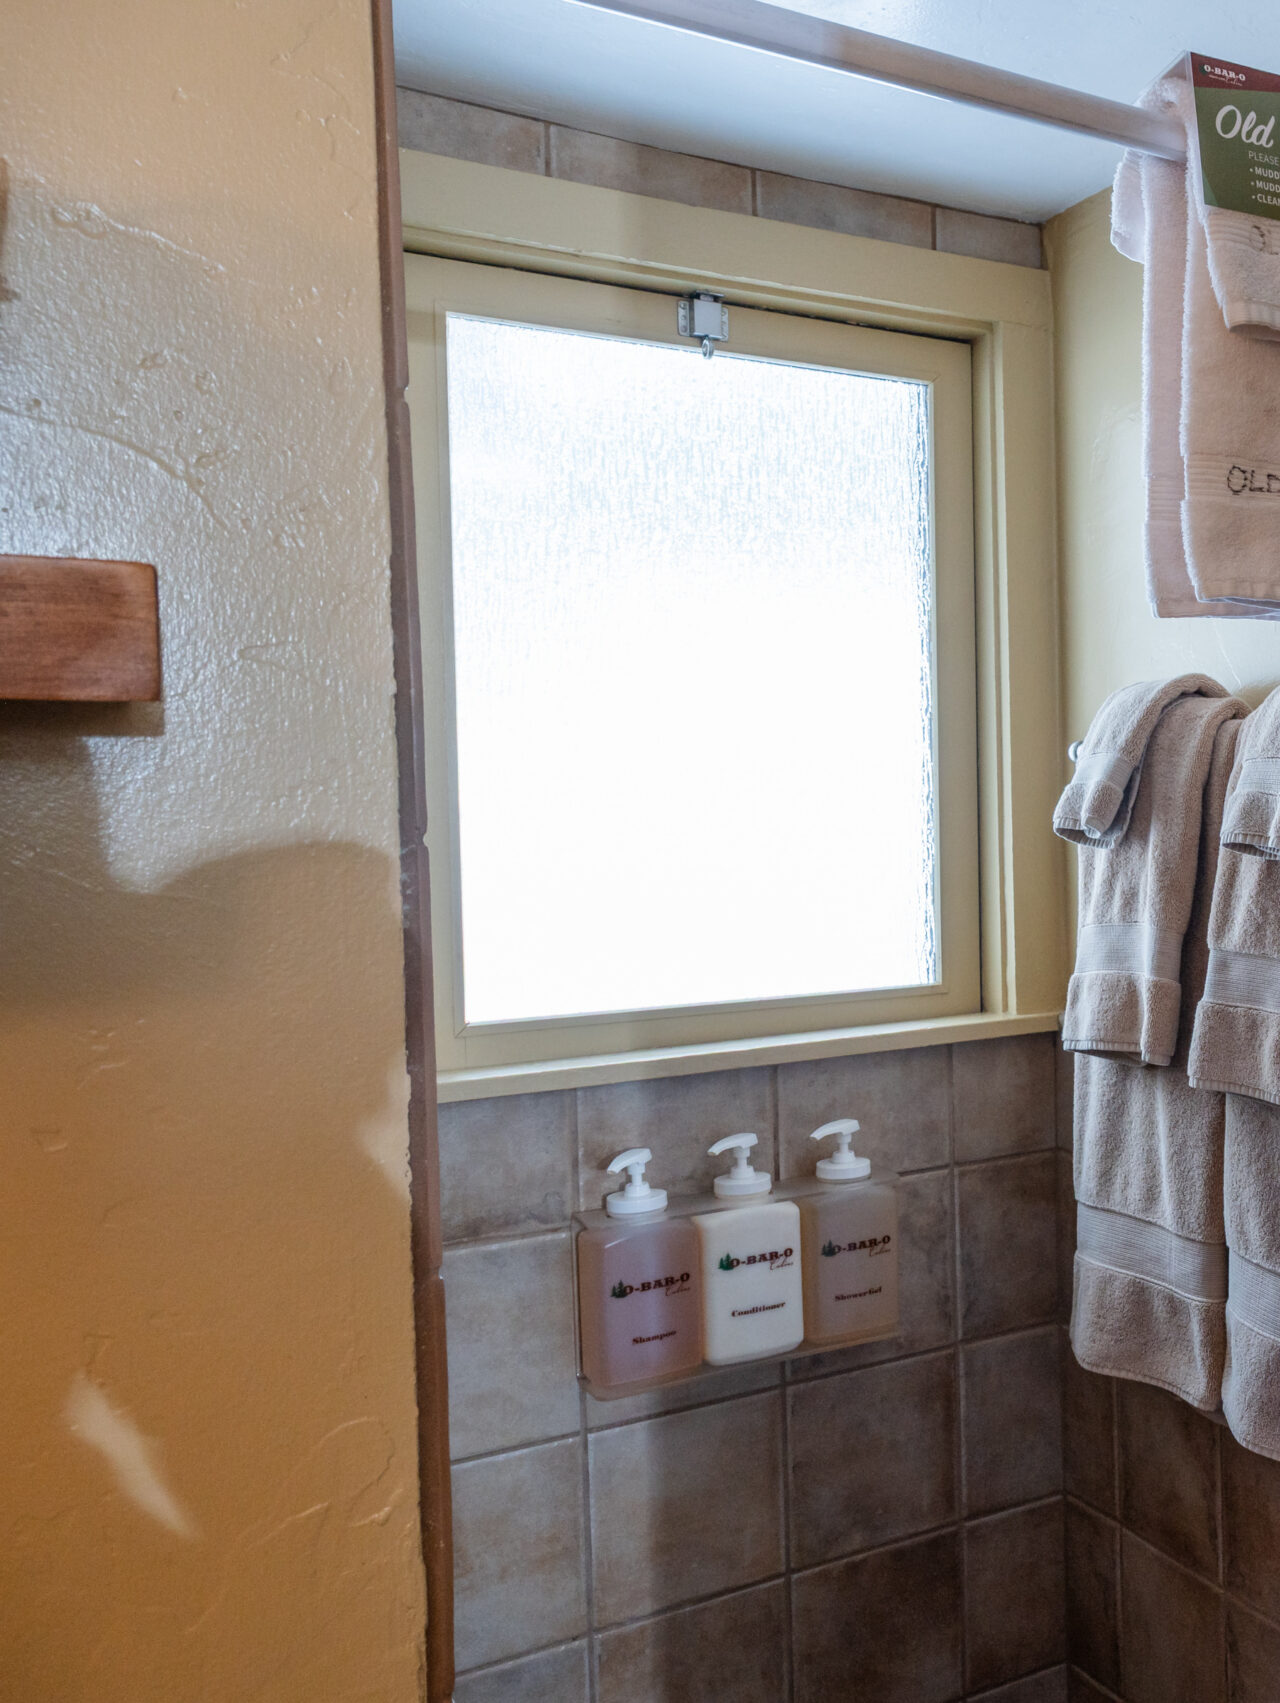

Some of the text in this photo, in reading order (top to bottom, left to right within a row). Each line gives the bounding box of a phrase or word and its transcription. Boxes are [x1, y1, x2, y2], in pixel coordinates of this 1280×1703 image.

[1204, 64, 1246, 81] O-BAR-O
[1215, 104, 1275, 148] Old
[1248, 151, 1279, 166] PLEASE
[833, 1235, 891, 1254] O-BAR-O
[729, 1247, 793, 1268] O-BAR-O
[623, 1272, 690, 1295] O-BAR-O
[731, 1302, 786, 1317] Conditioner
[632, 1330, 677, 1344] Shampoo
